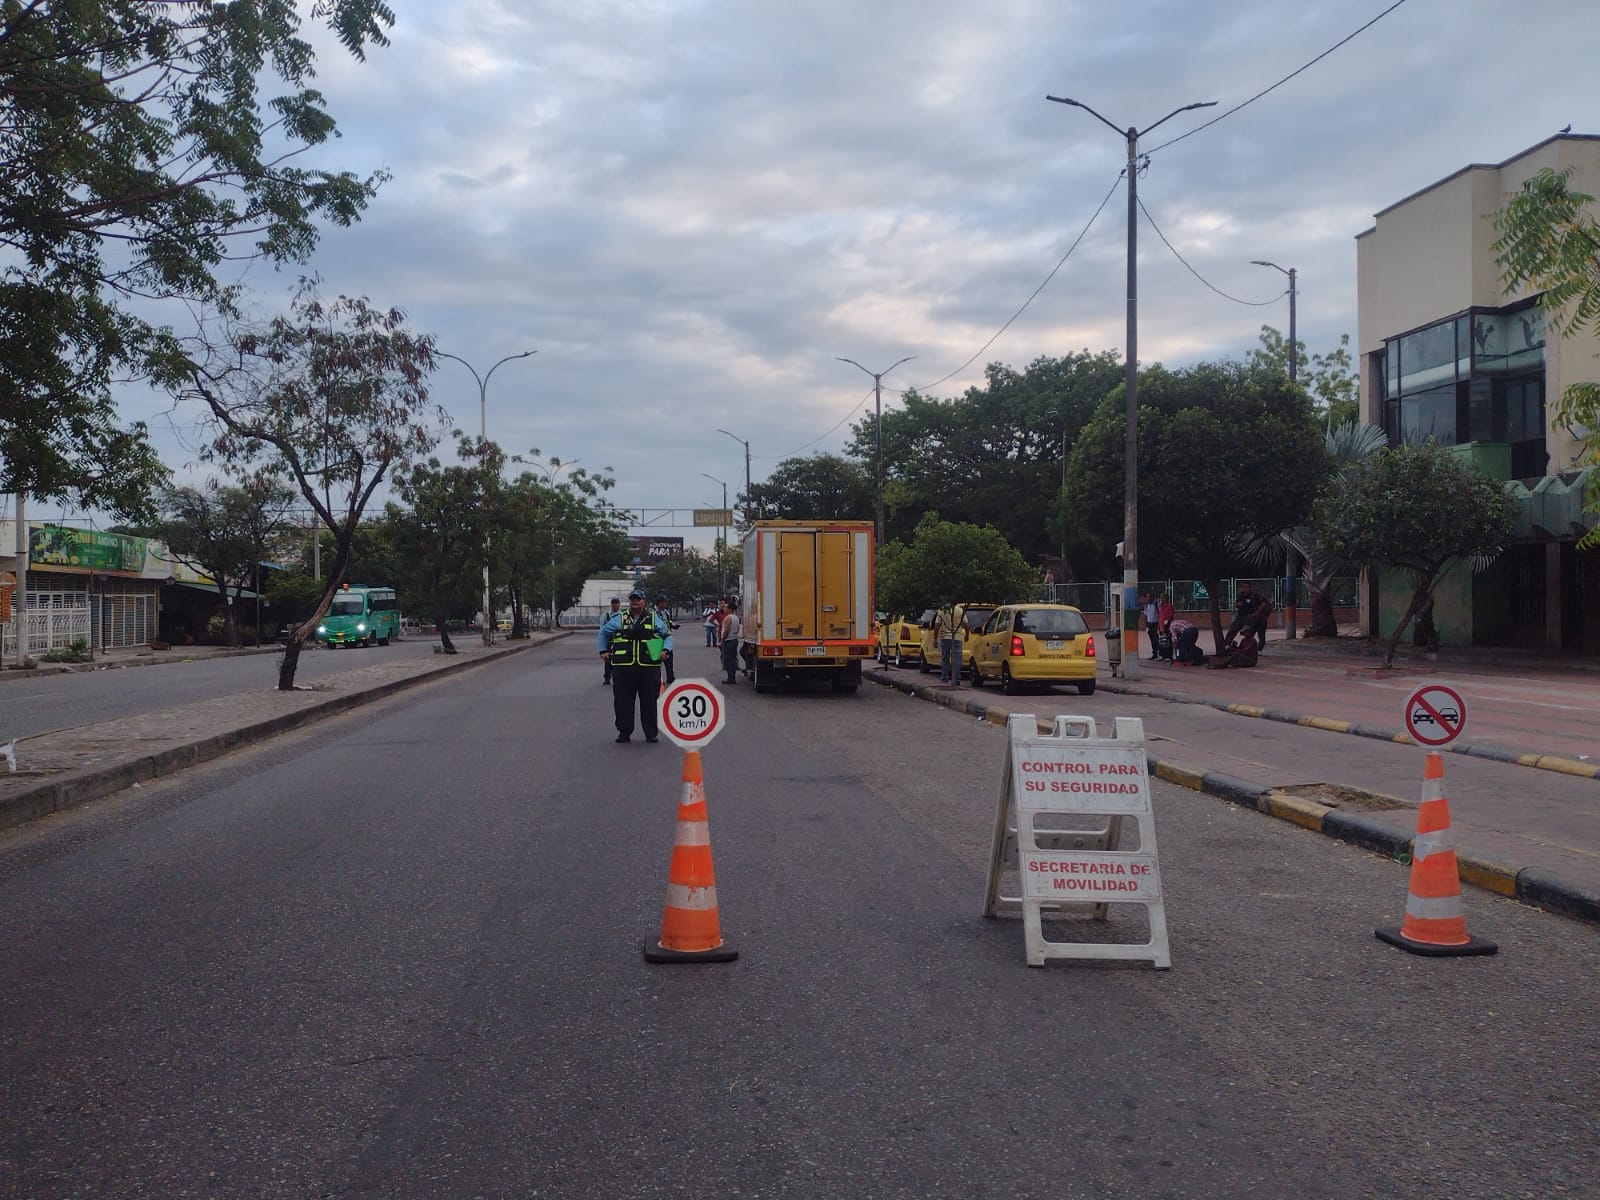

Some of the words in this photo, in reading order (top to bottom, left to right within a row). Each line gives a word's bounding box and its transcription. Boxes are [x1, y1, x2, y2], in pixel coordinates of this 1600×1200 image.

[649, 548, 670, 556] PARA
[677, 695, 707, 718] 30
[679, 719, 707, 729] km/h
[1022, 762, 1094, 774] CONTROL
[1099, 764, 1139, 775] PARA
[1025, 781, 1046, 792] SU
[1051, 782, 1139, 794] SEGURIDAD
[1130, 864, 1152, 875] DE
[1053, 878, 1138, 892] MOVILIDAD
